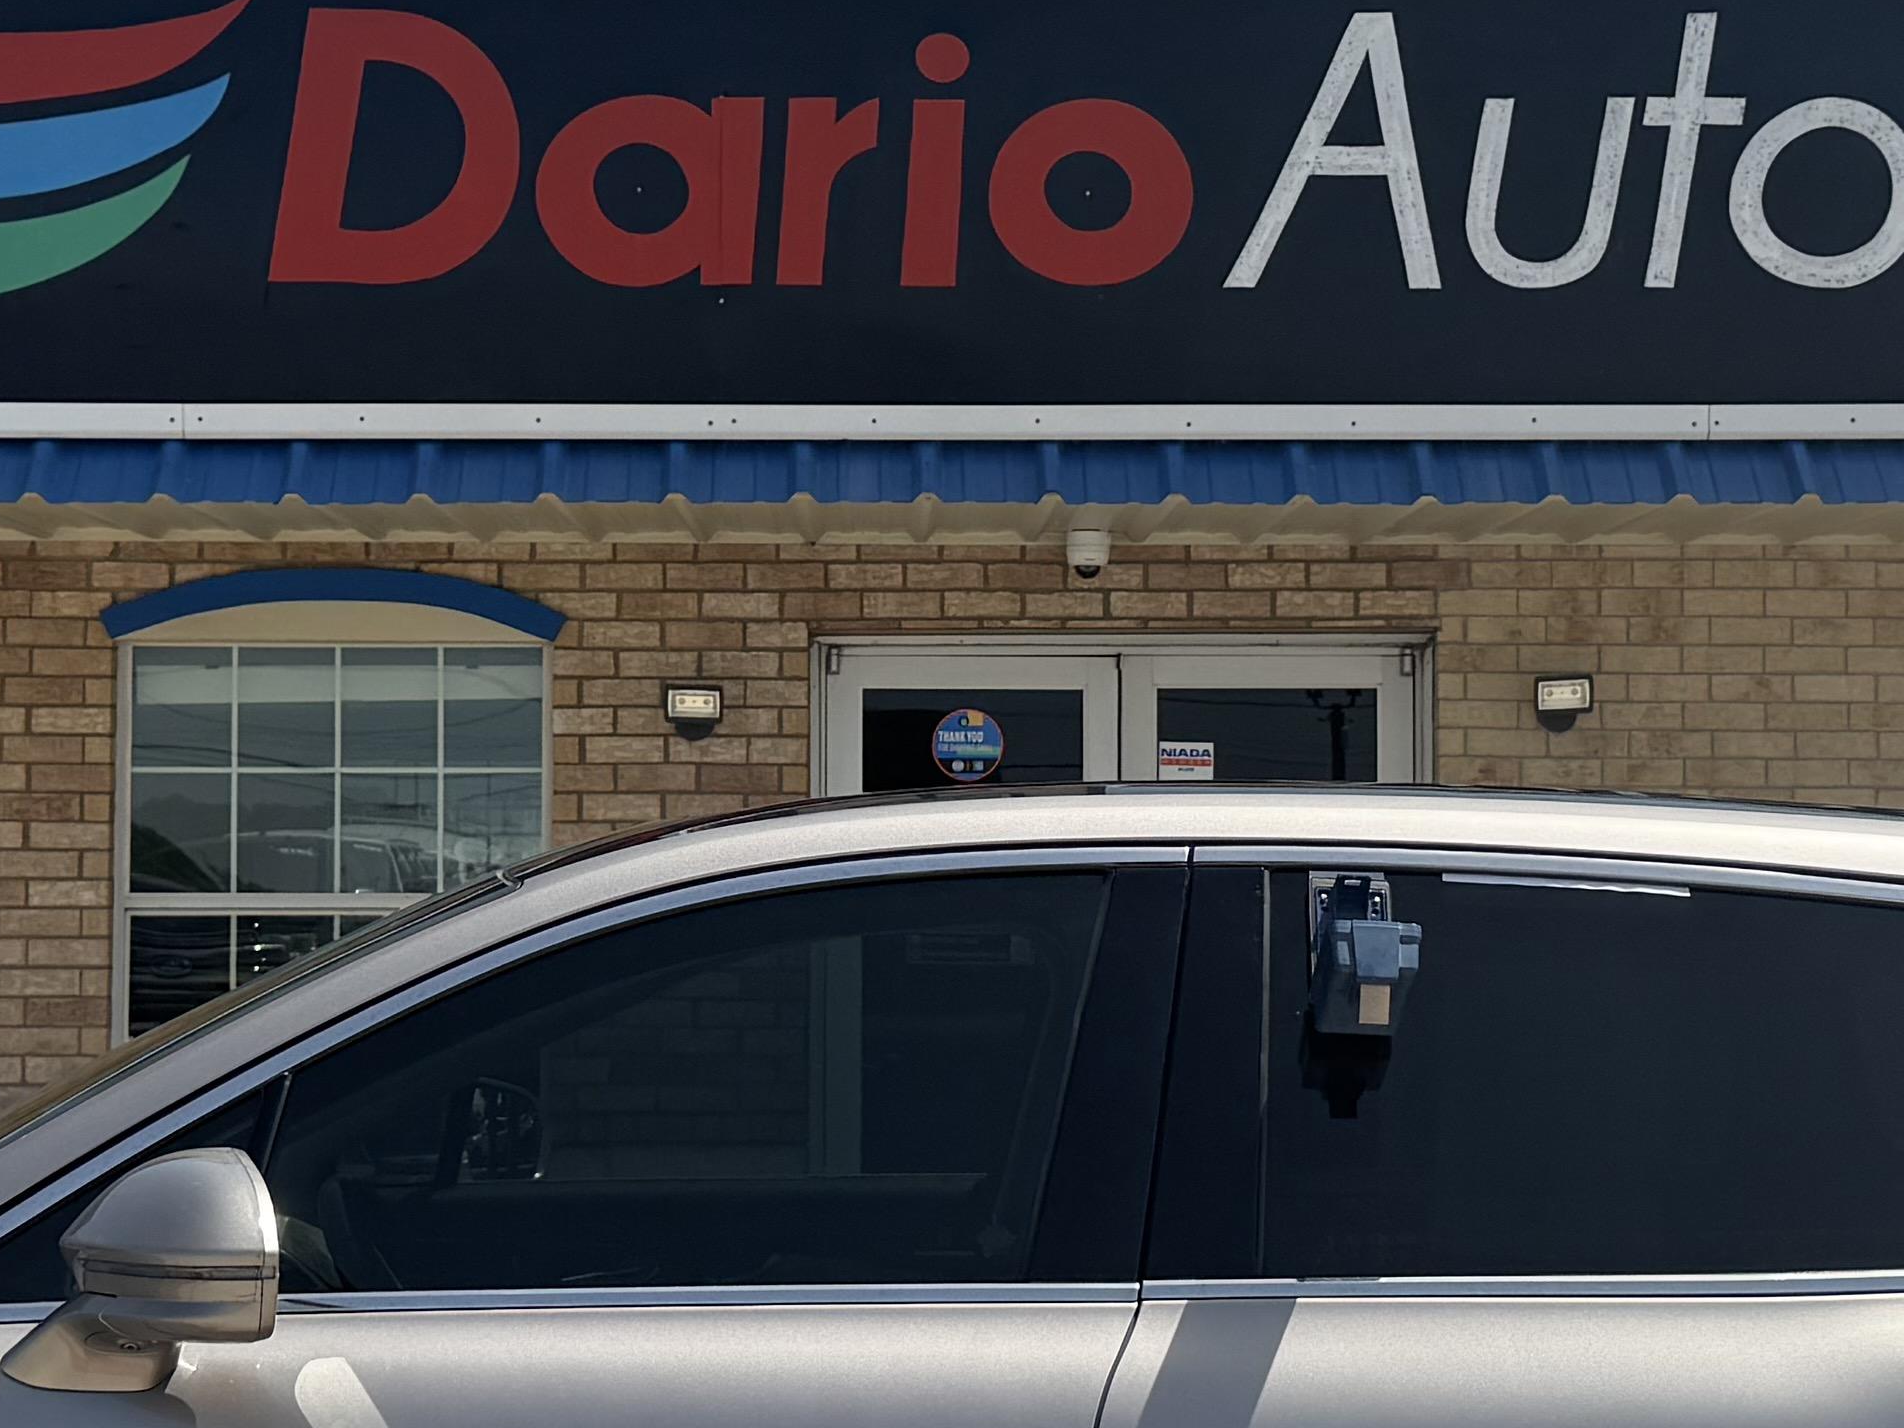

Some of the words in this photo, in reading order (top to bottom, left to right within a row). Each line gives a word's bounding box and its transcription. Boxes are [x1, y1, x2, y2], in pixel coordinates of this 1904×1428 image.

[266, 7, 1194, 287] Dario
[938, 730, 966, 743] THANK
[967, 730, 984, 743] YOU
[1161, 748, 1212, 758] NIADA
